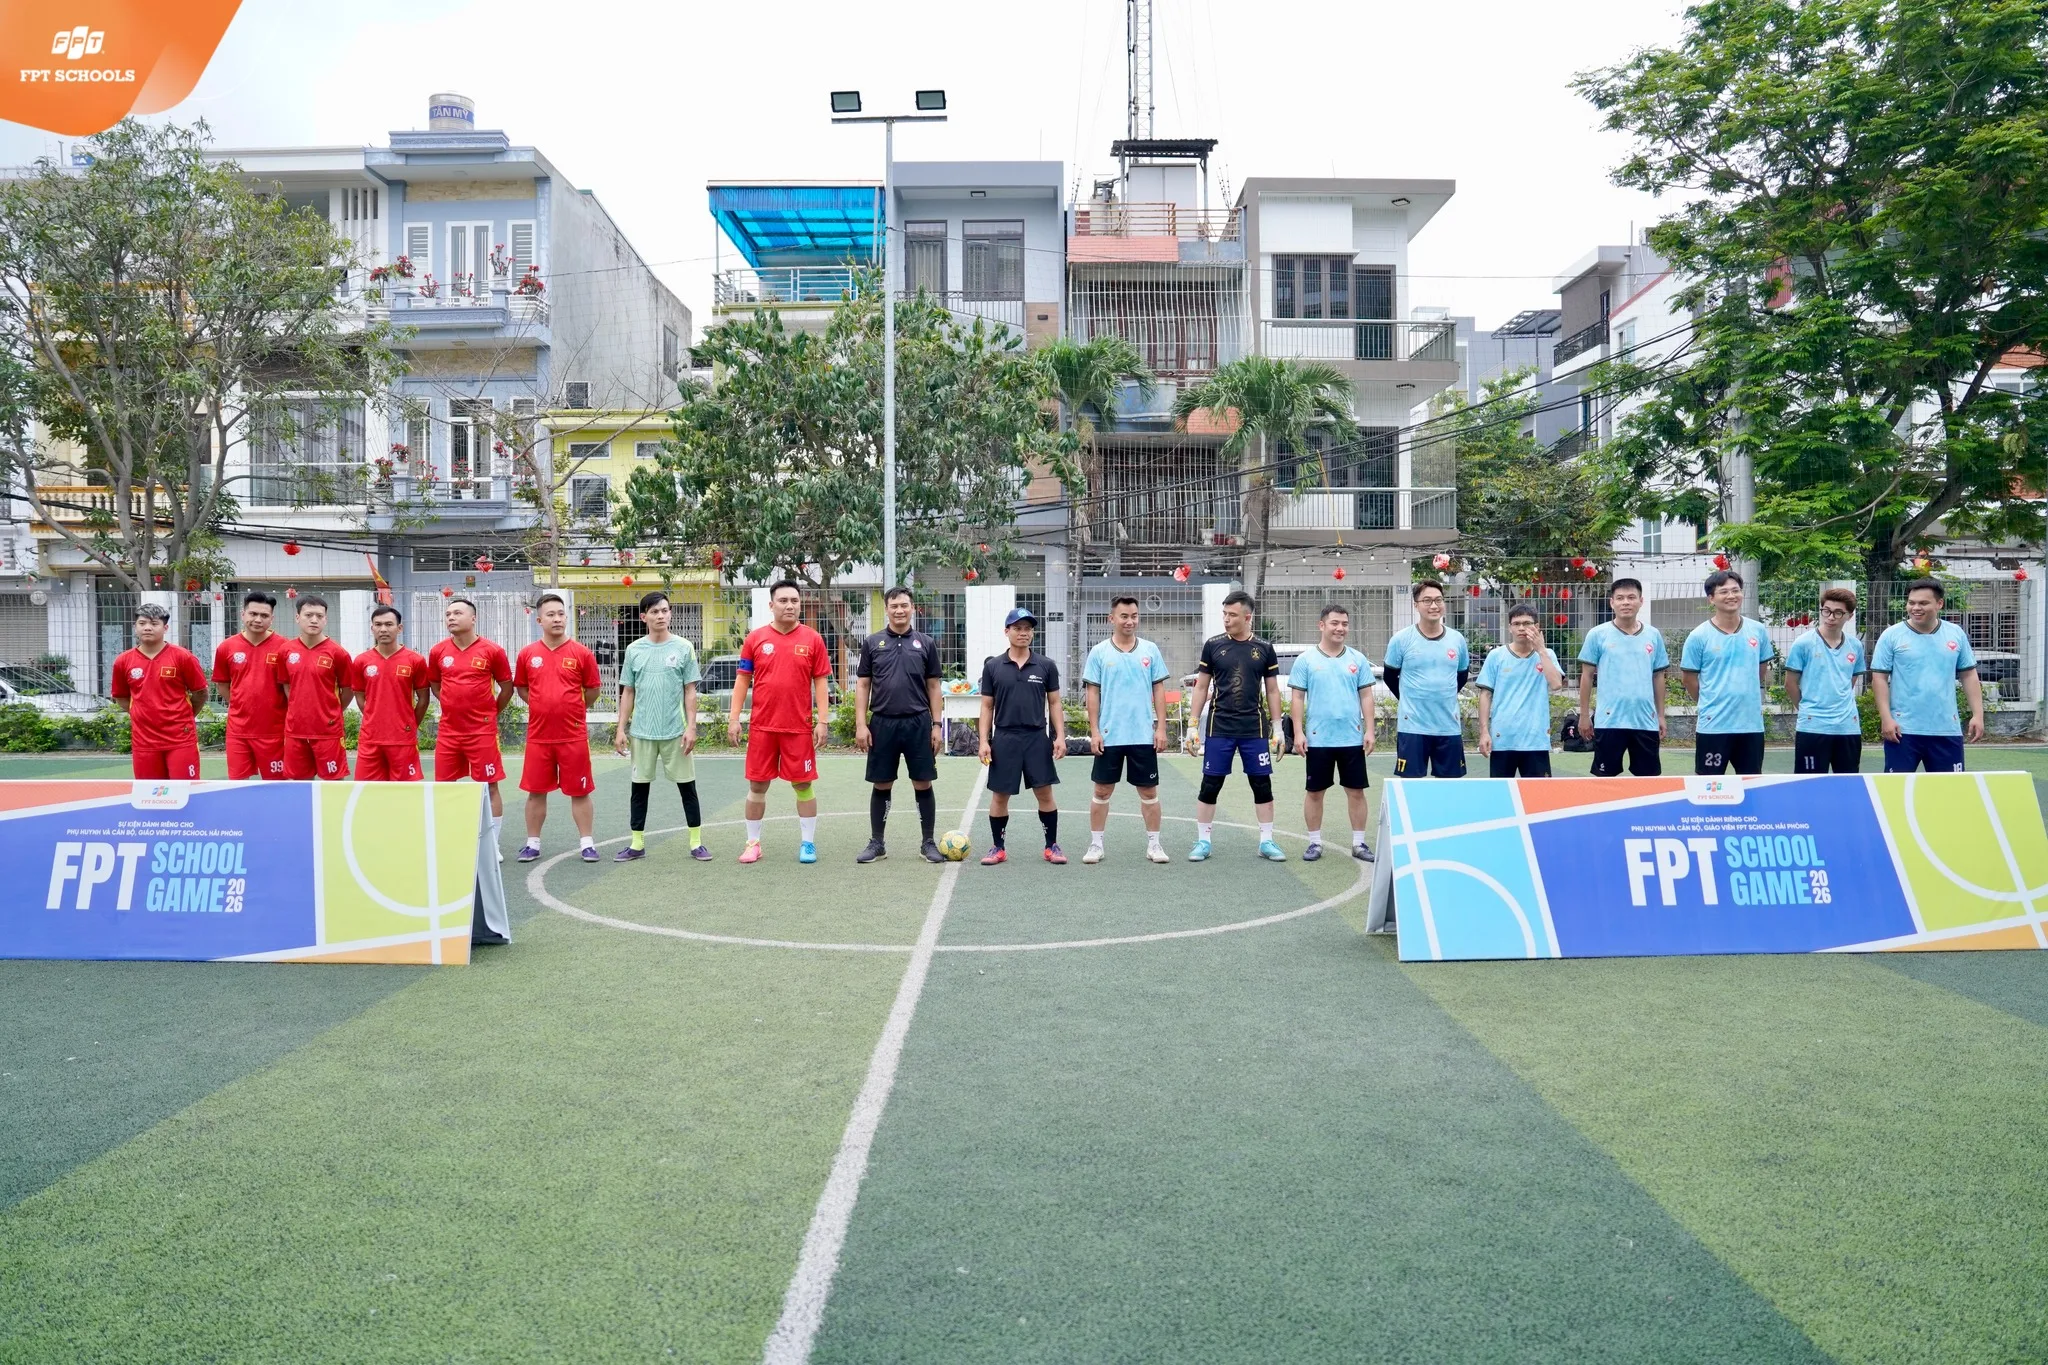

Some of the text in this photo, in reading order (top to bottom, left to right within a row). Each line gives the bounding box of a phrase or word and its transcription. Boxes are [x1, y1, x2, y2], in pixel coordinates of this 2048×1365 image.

[270, 760, 284, 773] 99
[326, 760, 338, 773] 18
[1258, 752, 1270, 766] 92
[1397, 758, 1406, 772] 17
[1705, 752, 1722, 766] 23
[1804, 756, 1815, 769] 11
[188, 764, 195, 777] 8
[580, 776, 587, 789] 7
[46, 841, 247, 911] FPT SCHOOL
[1624, 834, 1825, 906] FPT SCHOOL
[1809, 869, 1828, 887] 20
[227, 878, 246, 895] 20
[1729, 870, 1812, 906] GAME
[146, 877, 226, 912] GAME
[1812, 887, 1832, 904] 26
[224, 896, 244, 912] 26
